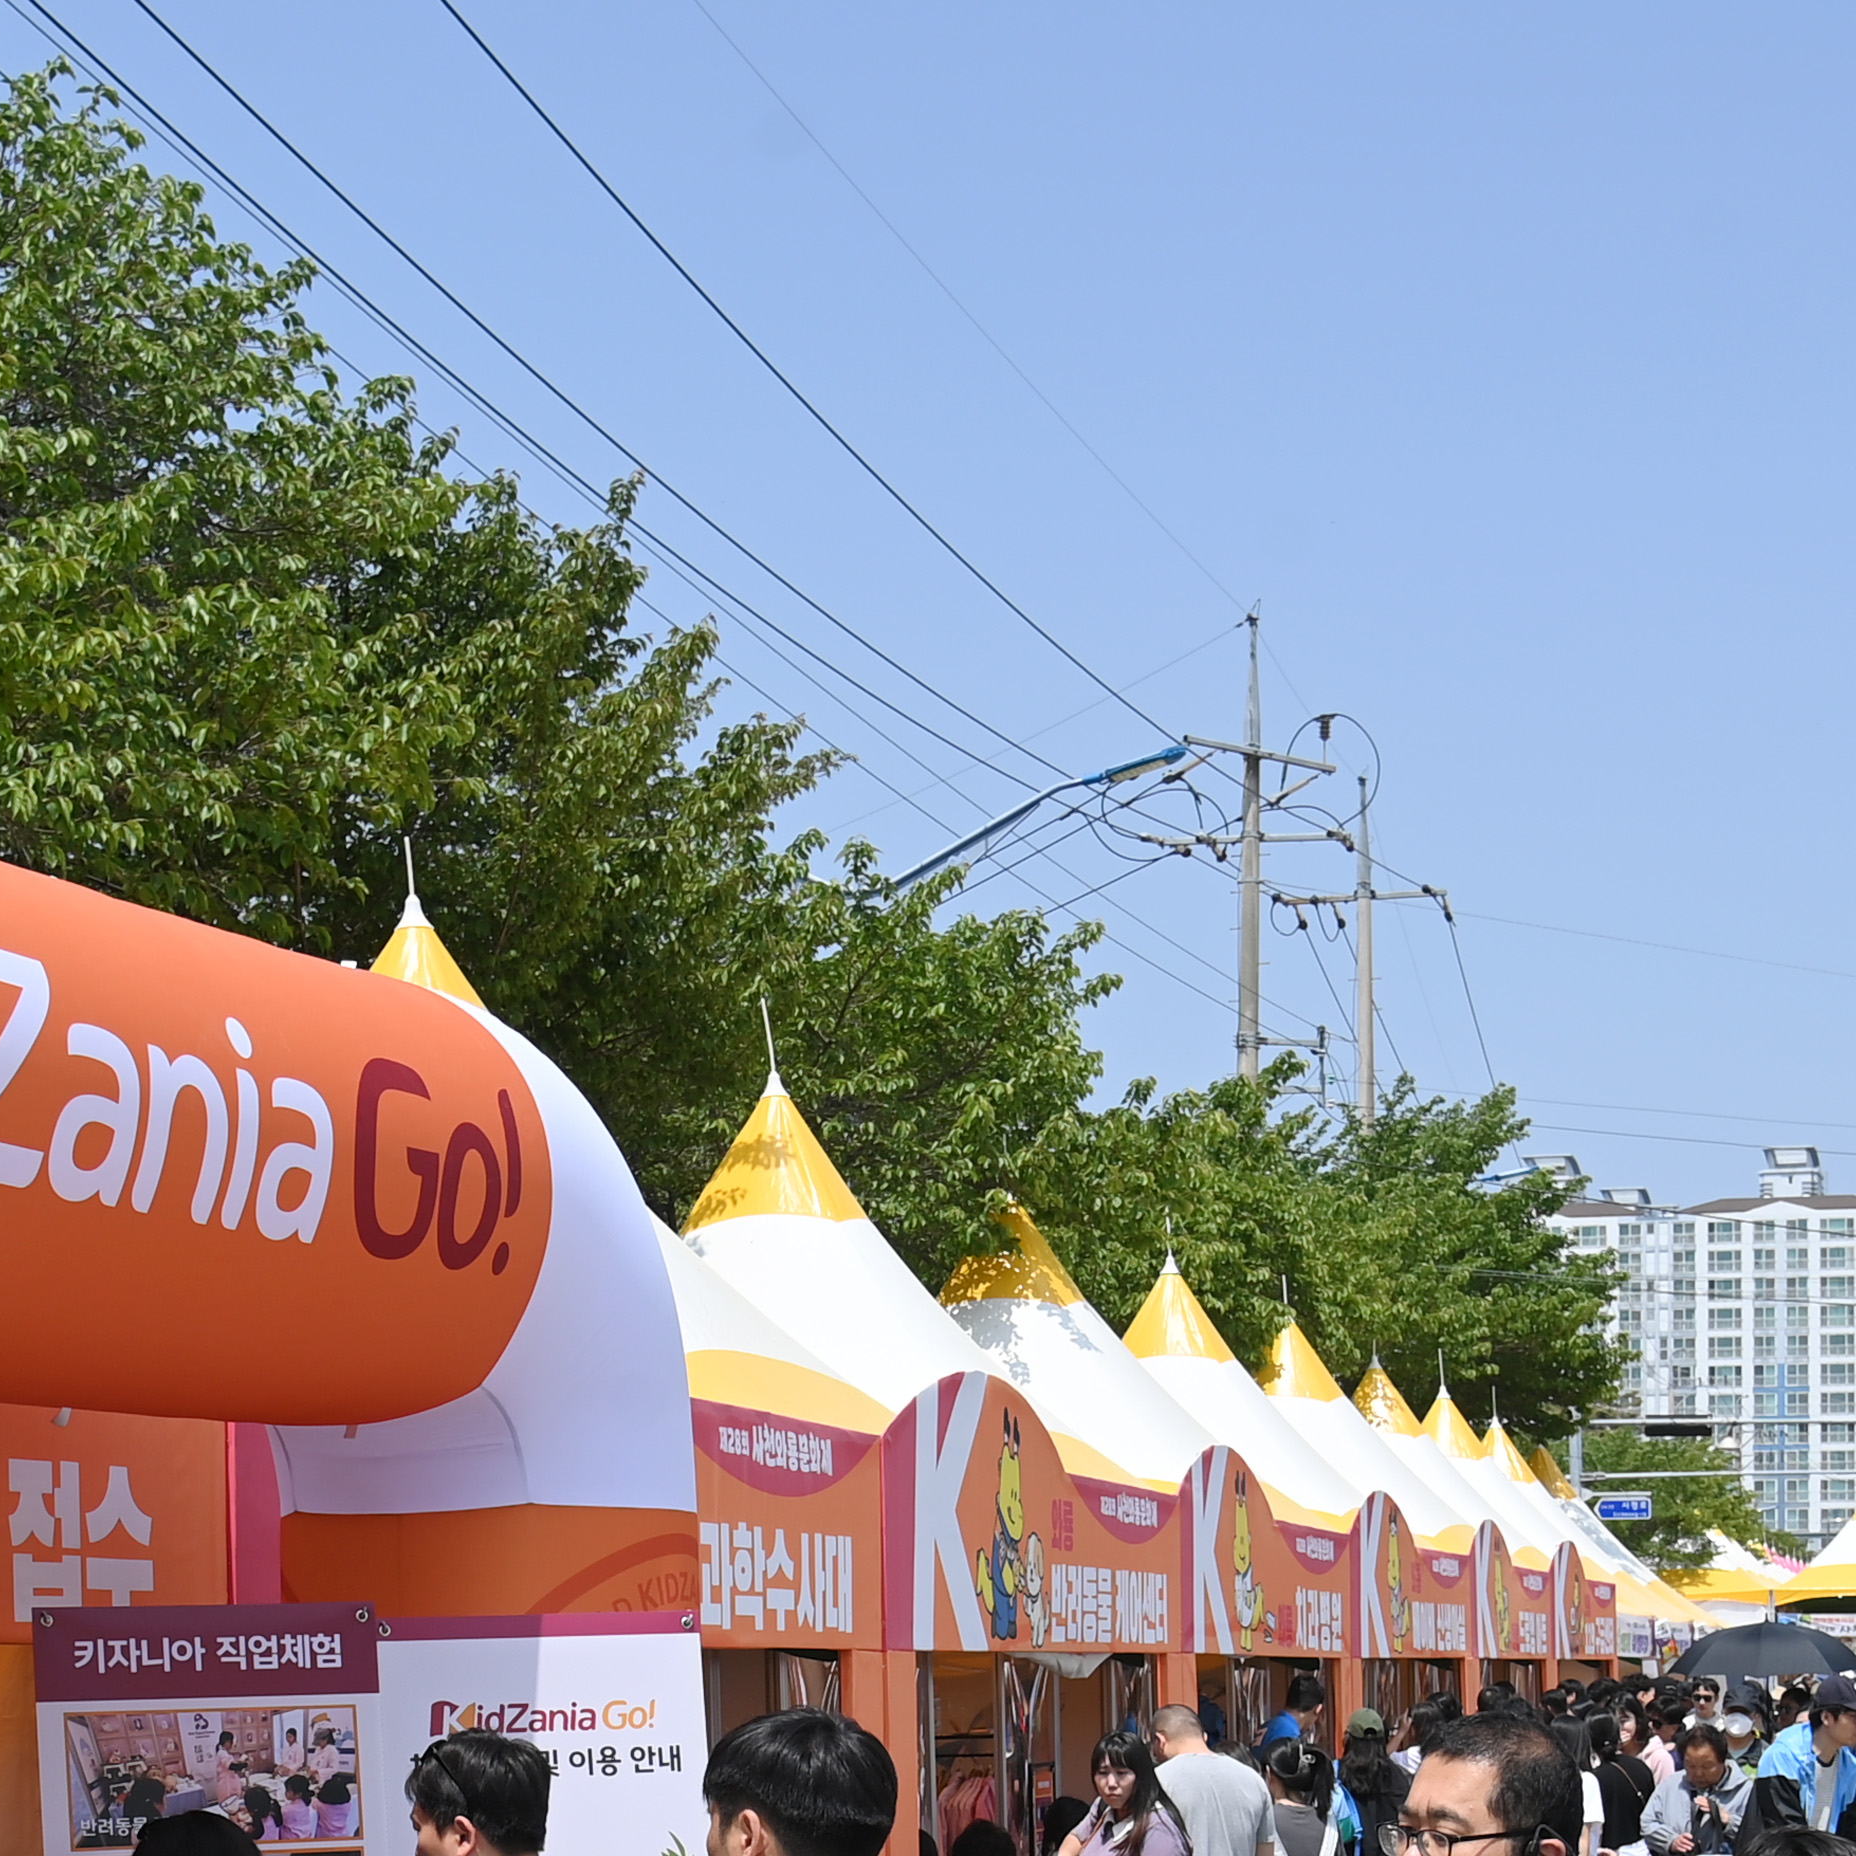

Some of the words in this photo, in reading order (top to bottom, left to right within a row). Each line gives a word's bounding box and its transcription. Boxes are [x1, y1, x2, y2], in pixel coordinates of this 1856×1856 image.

[352, 1056, 523, 1276] Go!
[752, 1422, 833, 1476] 사천와룡문화제
[8, 1457, 154, 1620] 접수
[700, 1520, 853, 1633] 과학수사대
[1050, 1564, 1113, 1643] 반려동물
[1115, 1570, 1169, 1644] 케어센터
[73, 1635, 206, 1674] 키자니아
[214, 1631, 344, 1672] 직업체험
[429, 1699, 597, 1737] KidZania
[601, 1698, 657, 1731] Go!
[568, 1745, 622, 1777] 이용
[629, 1744, 682, 1774] 안내
